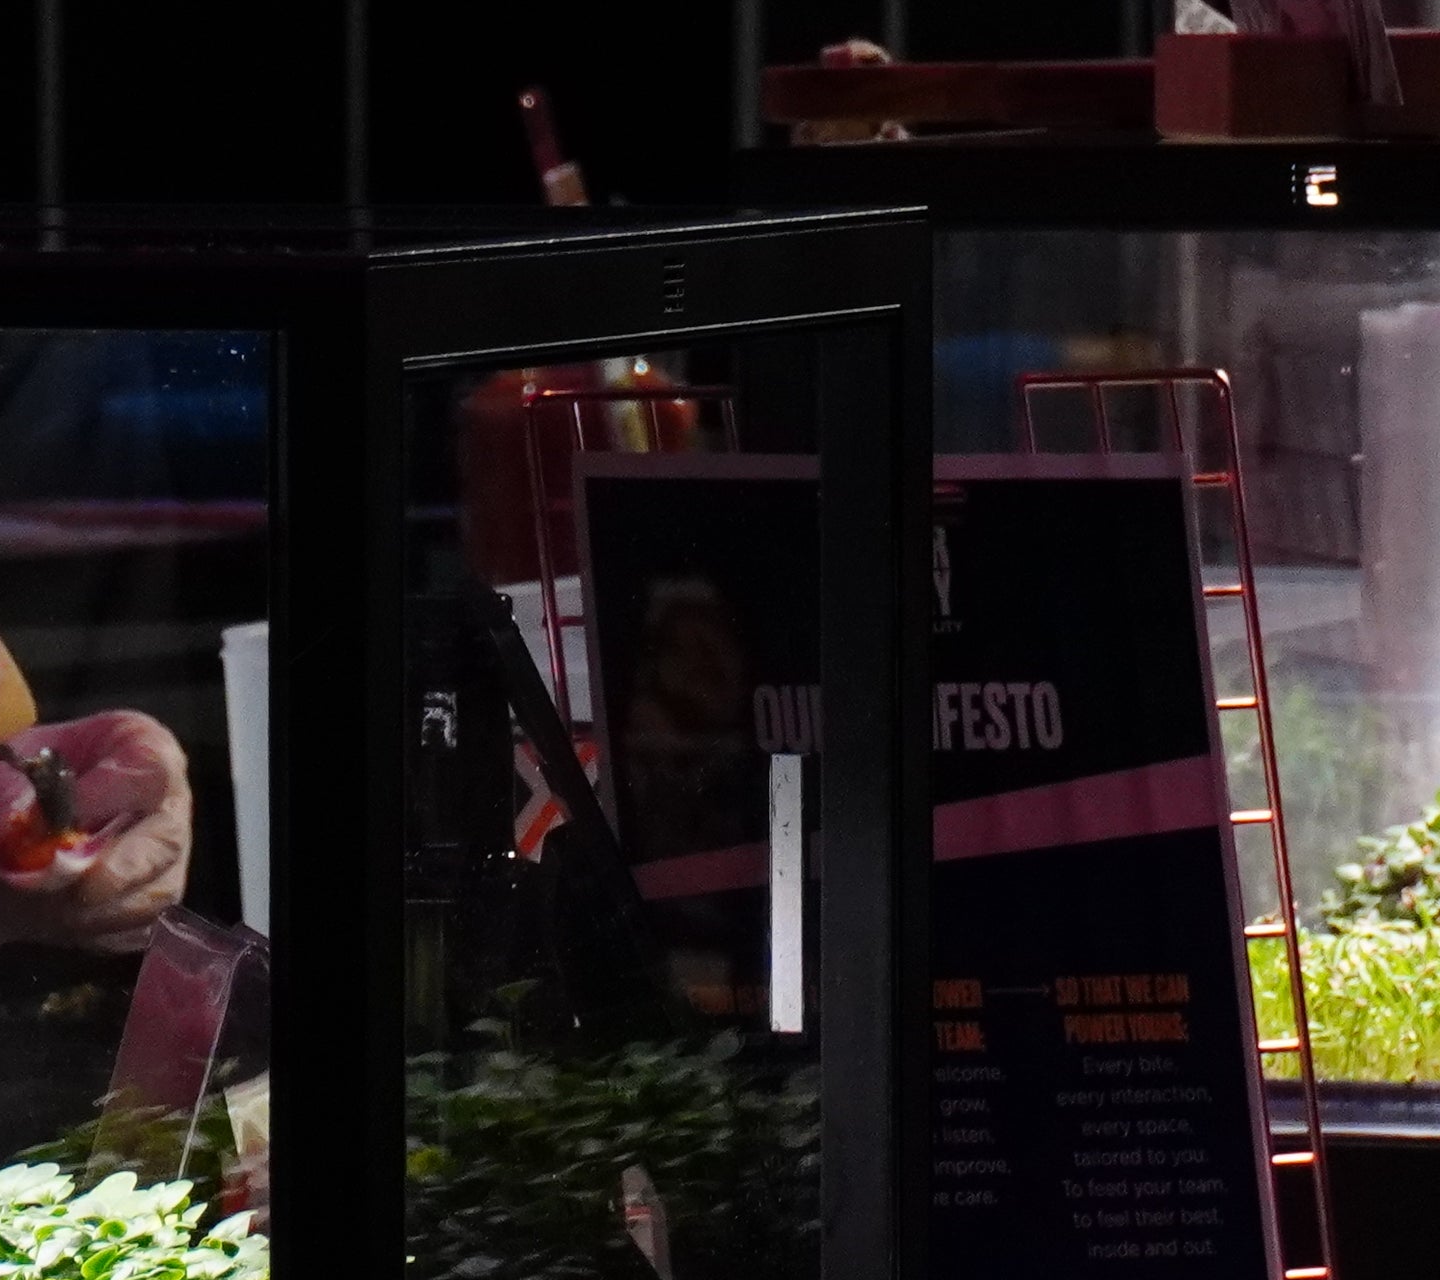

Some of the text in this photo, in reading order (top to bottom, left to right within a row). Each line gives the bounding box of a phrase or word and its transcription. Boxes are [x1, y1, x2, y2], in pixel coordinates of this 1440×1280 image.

[1081, 975, 1121, 1005] THAT
[1123, 973, 1154, 1005] WE
[1155, 972, 1190, 1004] CAN
[1082, 1055, 1133, 1077] Every
[1056, 1086, 1213, 1110] every interaction,
[1081, 1120, 1131, 1138] every
[1073, 1147, 1142, 1167] tailored
[1146, 1148, 1166, 1166] to
[1061, 1178, 1084, 1198] To
[1088, 1177, 1128, 1197] feed
[1134, 1180, 1172, 1200] your
[1072, 1212, 1092, 1229] to
[1097, 1208, 1130, 1228] feel
[1135, 1207, 1175, 1227] their
[1088, 1239, 1140, 1259] inside
[1144, 1238, 1178, 1257] and
